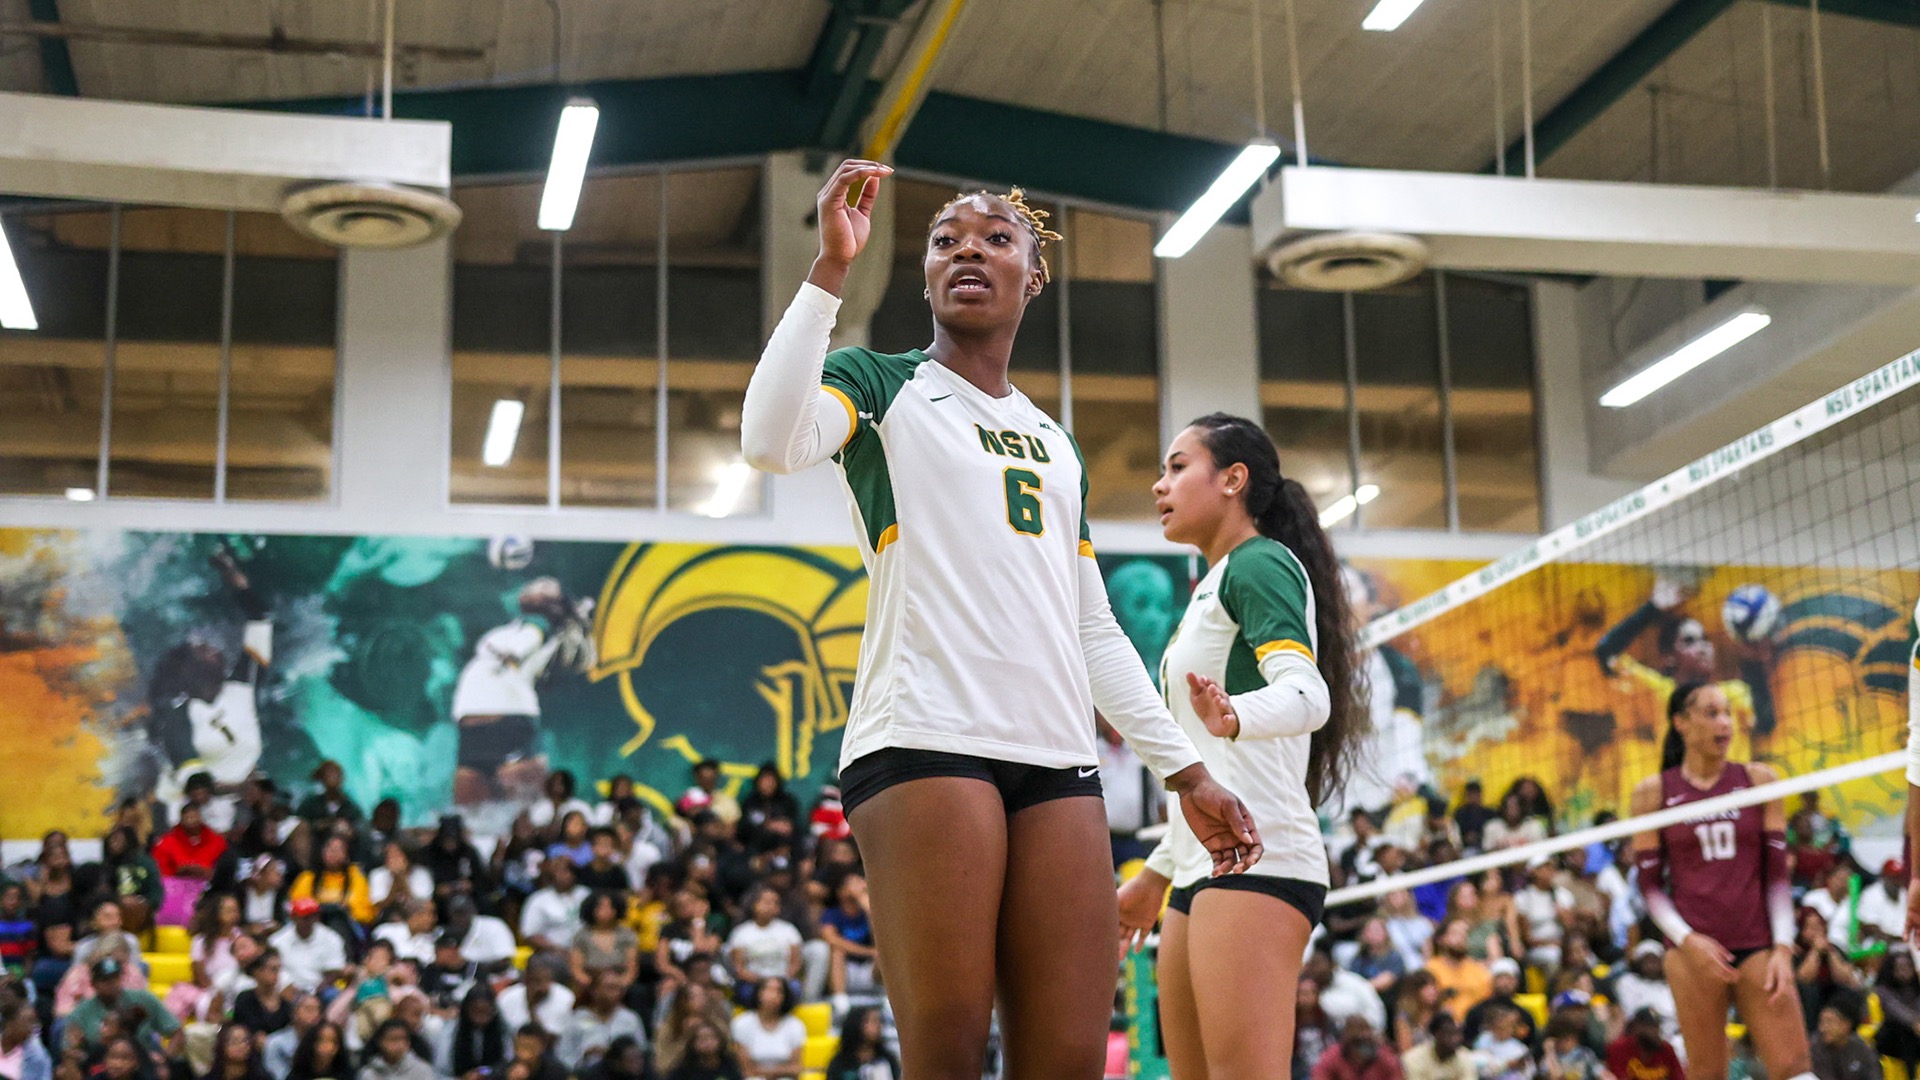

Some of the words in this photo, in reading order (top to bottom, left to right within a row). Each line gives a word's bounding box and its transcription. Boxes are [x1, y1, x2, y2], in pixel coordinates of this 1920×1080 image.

[1825, 388, 1852, 416] NSU
[973, 421, 1051, 464] NSU
[1002, 465, 1046, 539] 6
[1694, 820, 1737, 862] 10
